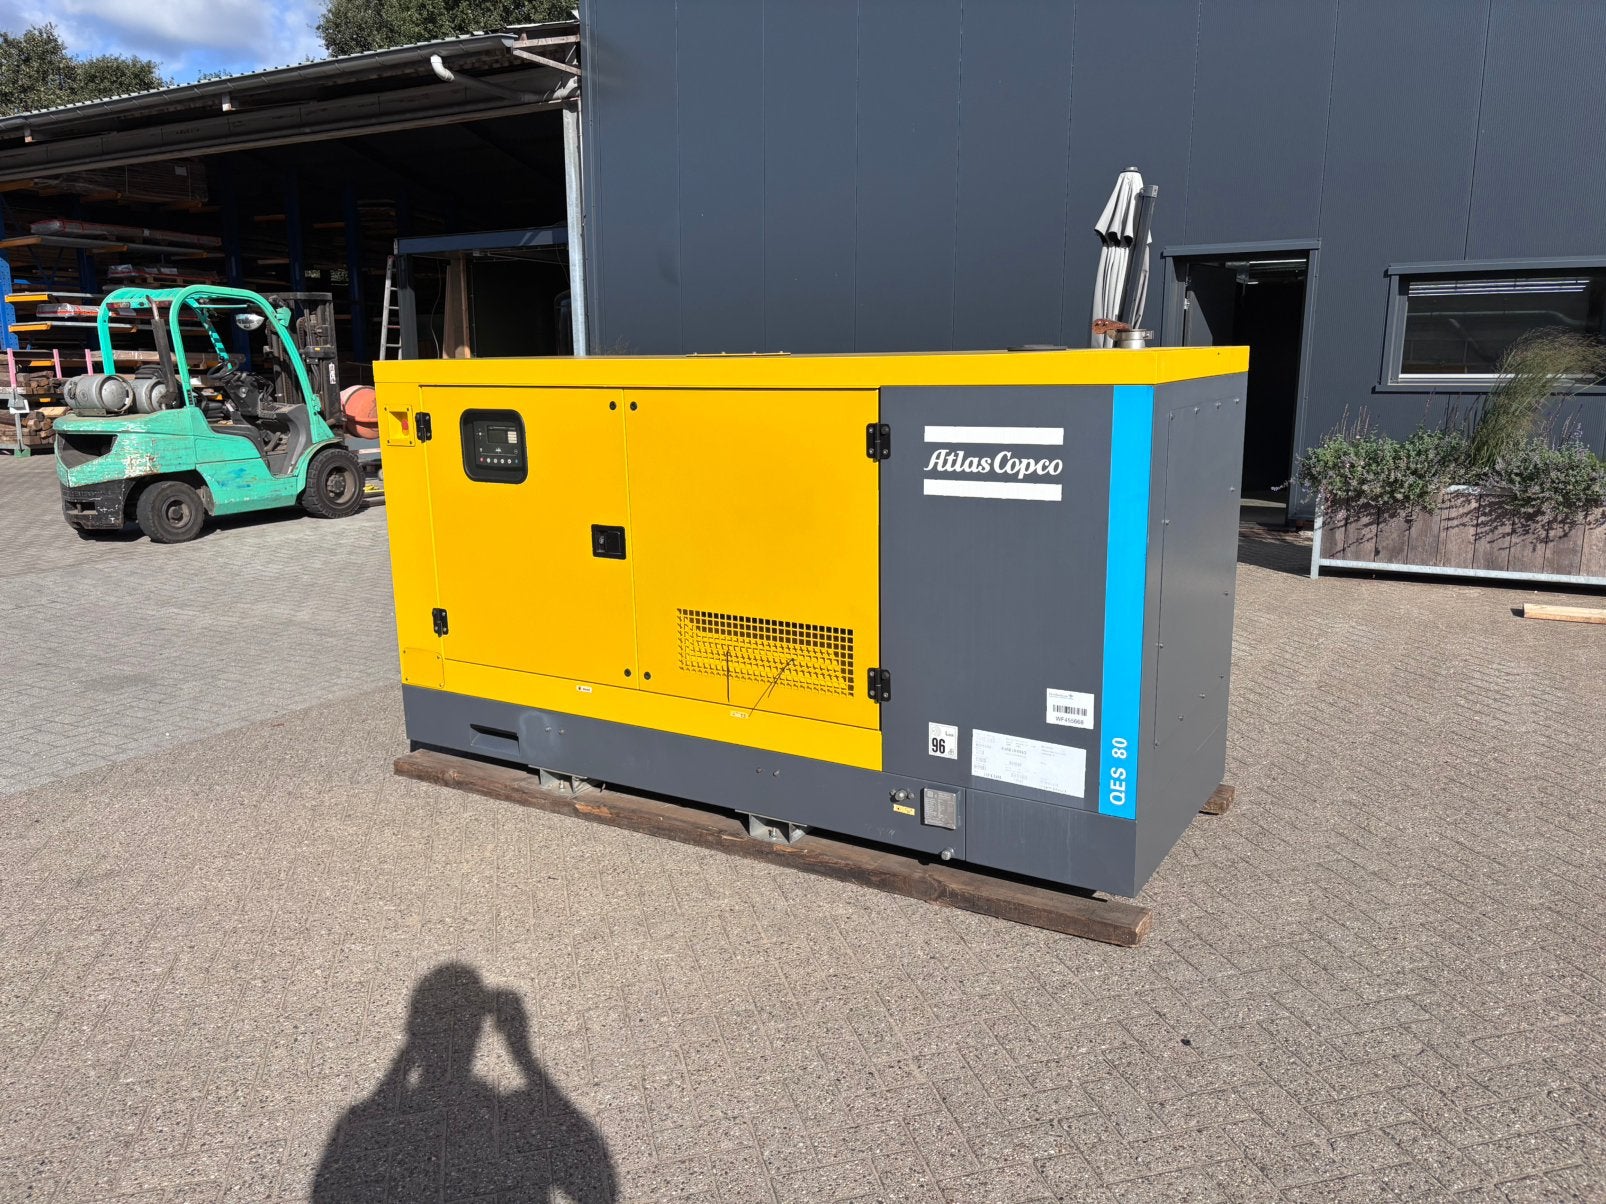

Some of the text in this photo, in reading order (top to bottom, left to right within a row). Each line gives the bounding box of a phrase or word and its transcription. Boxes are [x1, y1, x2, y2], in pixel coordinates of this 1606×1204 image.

[924, 449, 1063, 479] Atlas Copco
[931, 737, 946, 754] 96
[1109, 737, 1128, 806] QES 80
